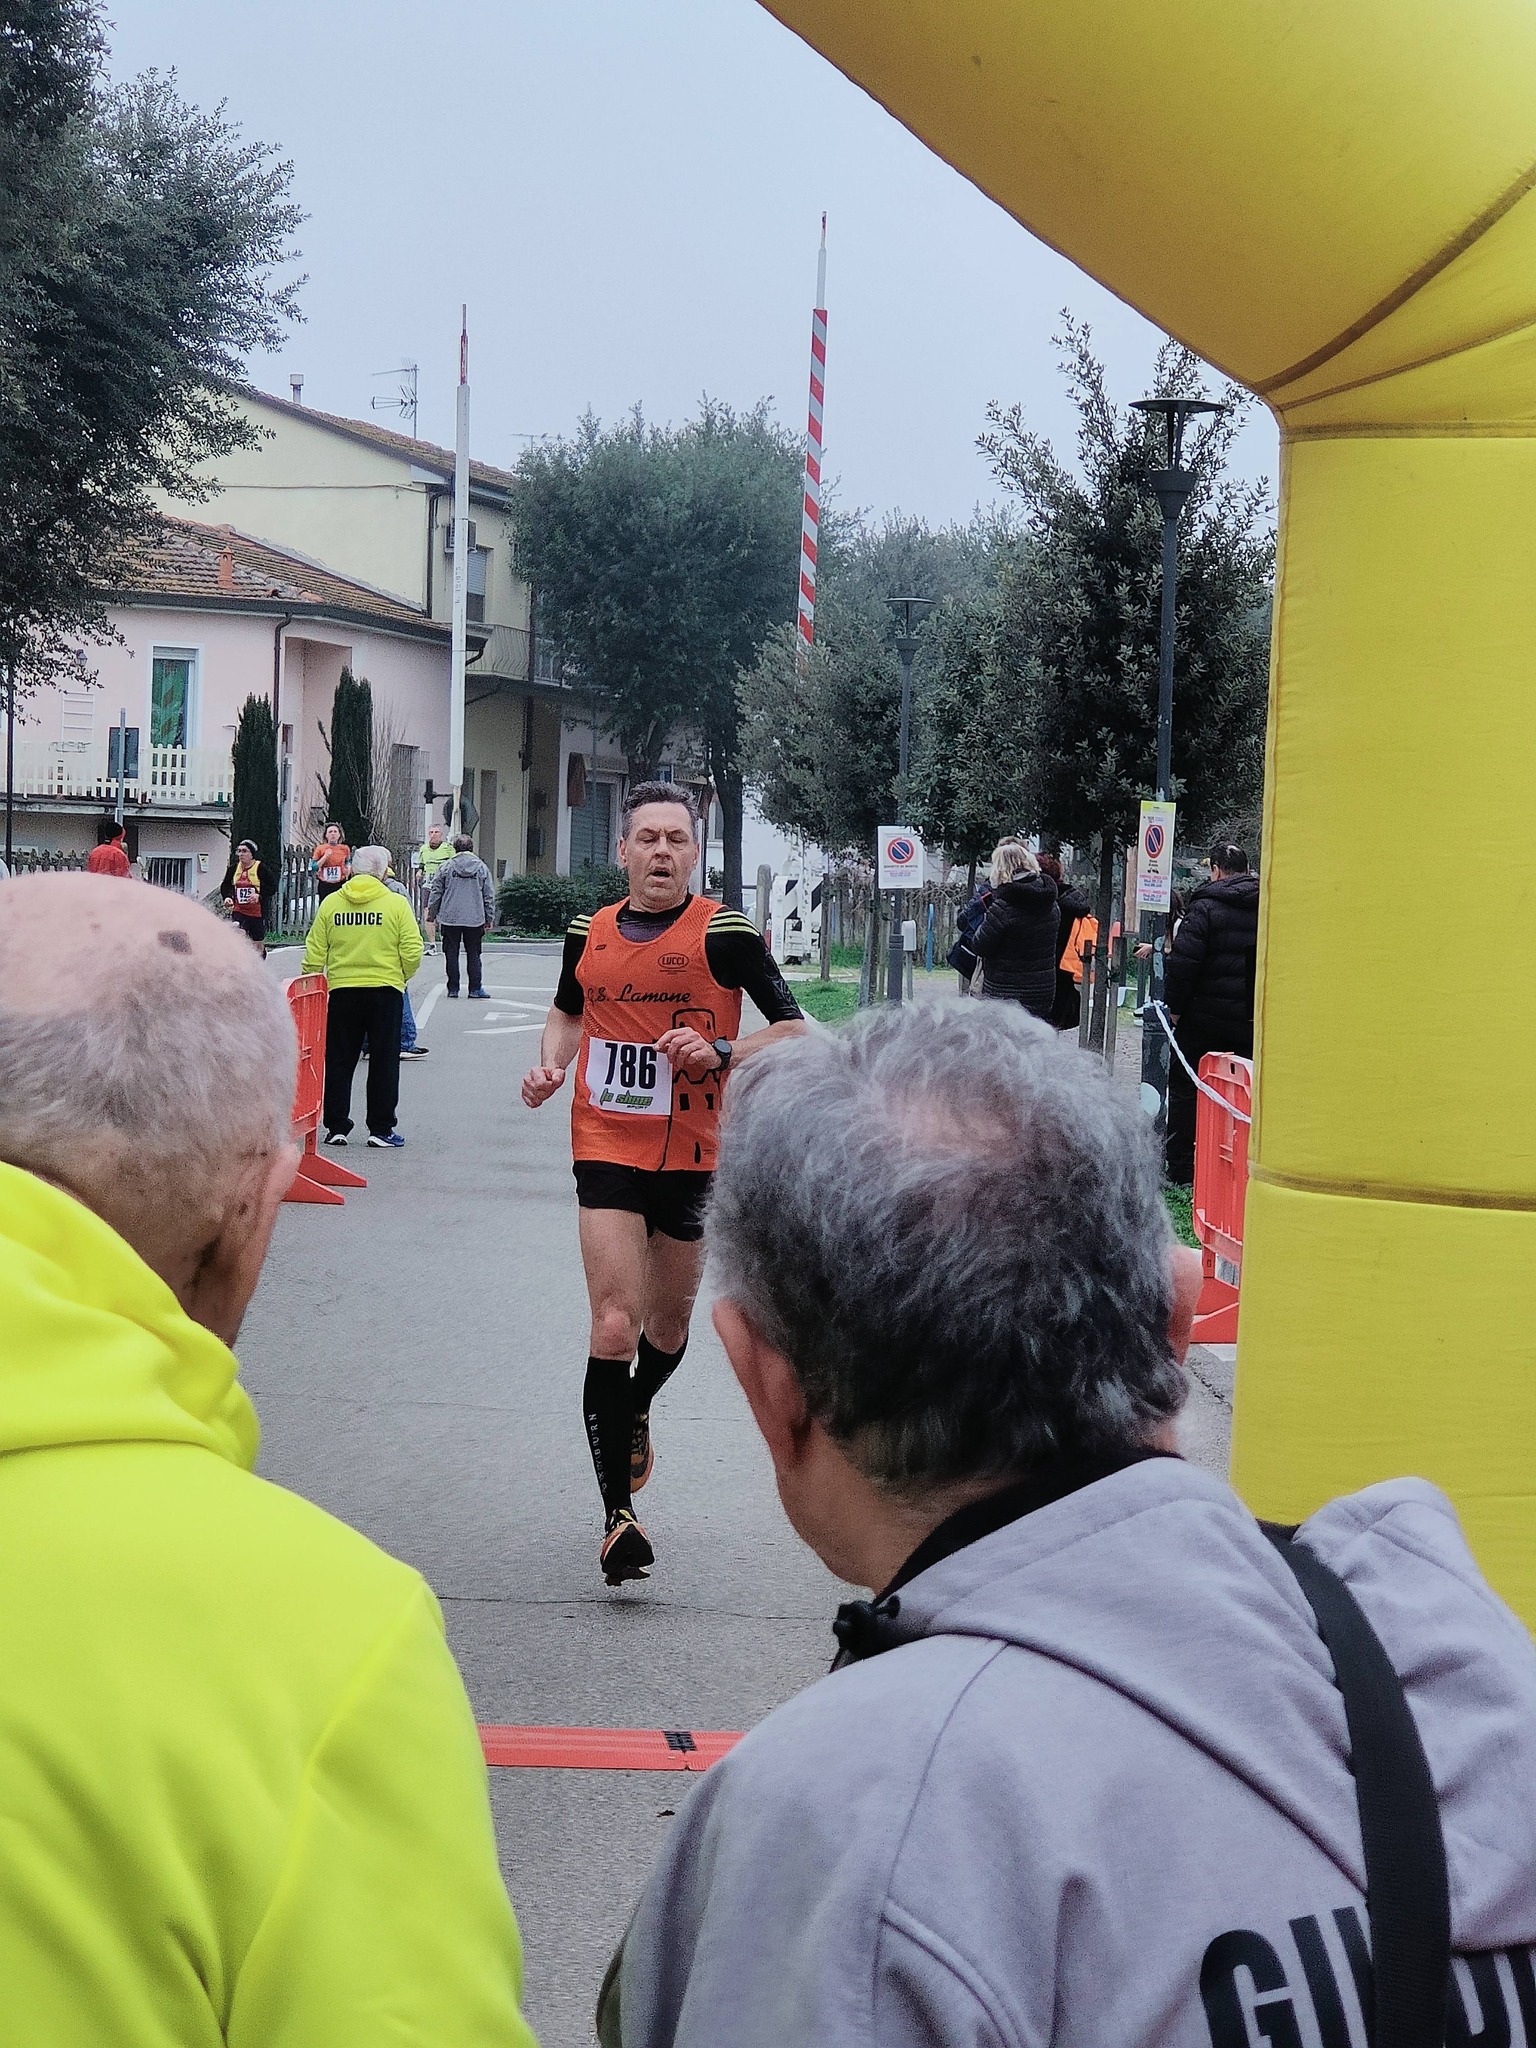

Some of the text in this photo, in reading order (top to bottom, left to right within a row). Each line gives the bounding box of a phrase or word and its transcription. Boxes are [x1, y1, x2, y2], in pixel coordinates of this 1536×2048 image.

[334, 912, 383, 926] GIUDICE
[661, 956, 685, 966] LUCCI
[615, 983, 691, 1003] Lamone
[605, 1042, 657, 1089] 786
